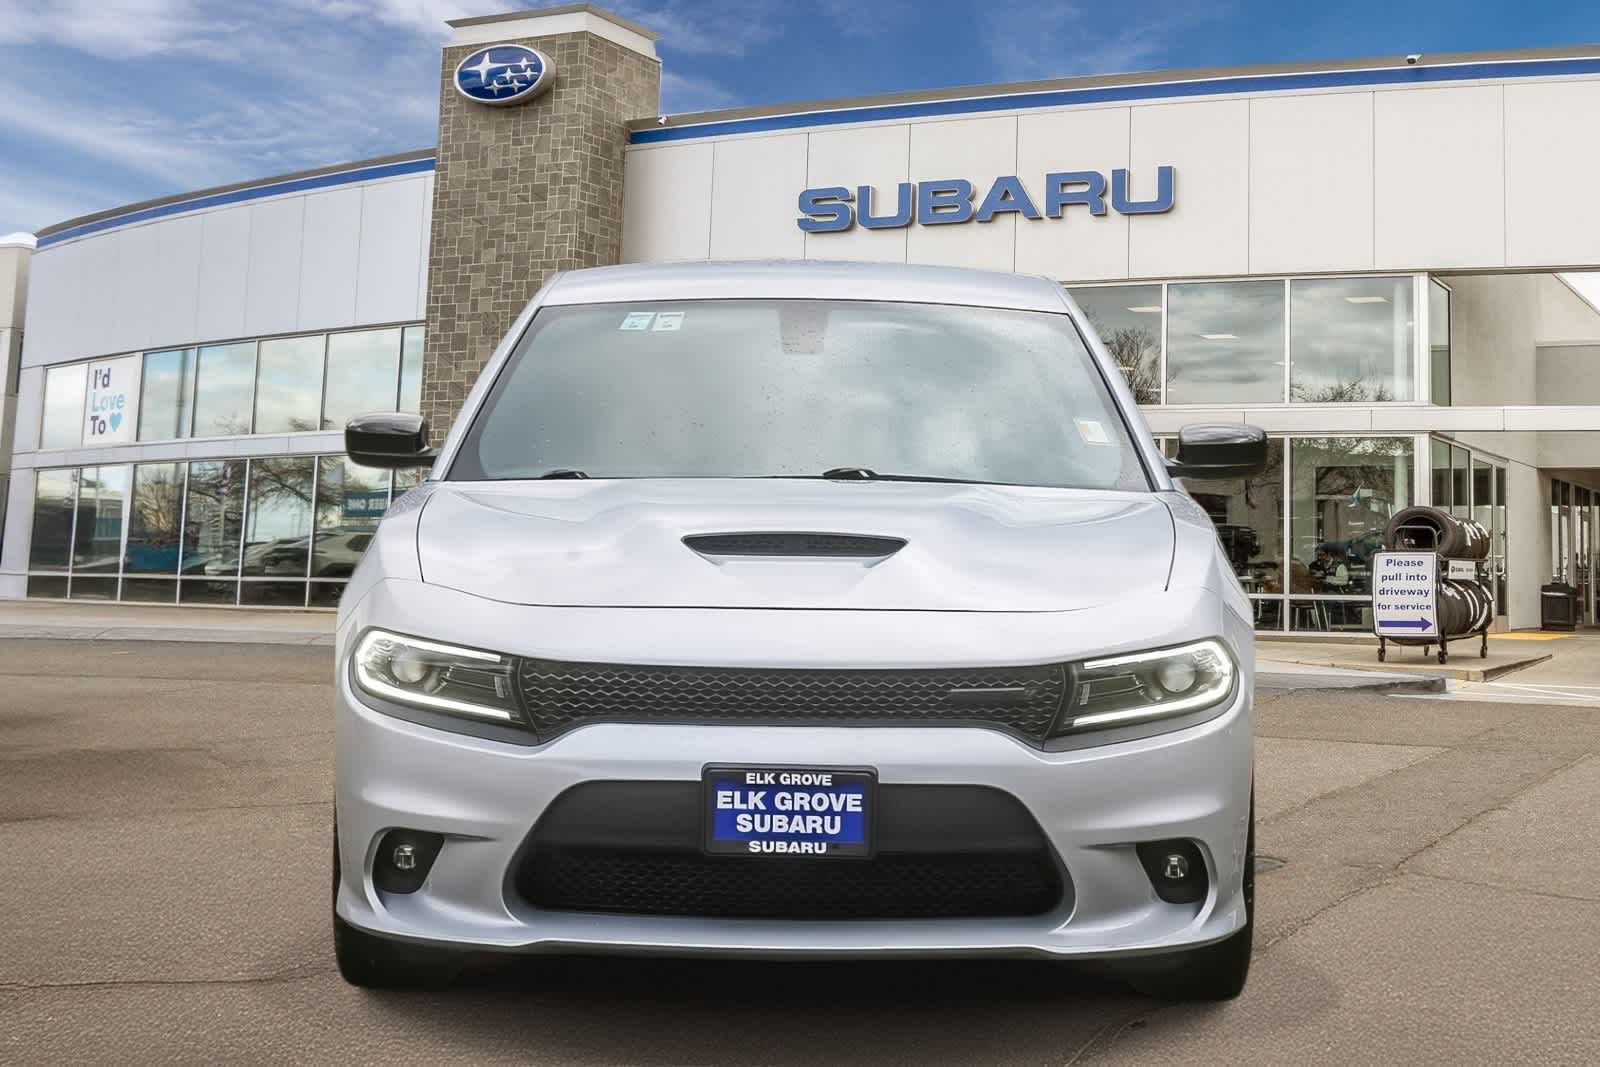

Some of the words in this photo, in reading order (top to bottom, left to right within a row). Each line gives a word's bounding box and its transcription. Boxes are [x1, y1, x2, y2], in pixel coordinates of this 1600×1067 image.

[796, 165, 1176, 233] SUBARU
[94, 368, 111, 389] I'd
[91, 391, 125, 412] Love
[90, 415, 106, 436] To
[1386, 558, 1424, 567] Please
[1381, 572, 1402, 583] pull
[1405, 572, 1428, 582] into
[1378, 587, 1430, 598] driveway
[1377, 602, 1391, 611] for
[1394, 602, 1432, 611] service
[746, 772, 775, 785] ELK
[779, 773, 832, 786] GROVE
[716, 790, 767, 810] ELK
[774, 792, 862, 812] GROVE
[736, 813, 841, 835] SUBARU
[748, 841, 827, 854] SUBARU
